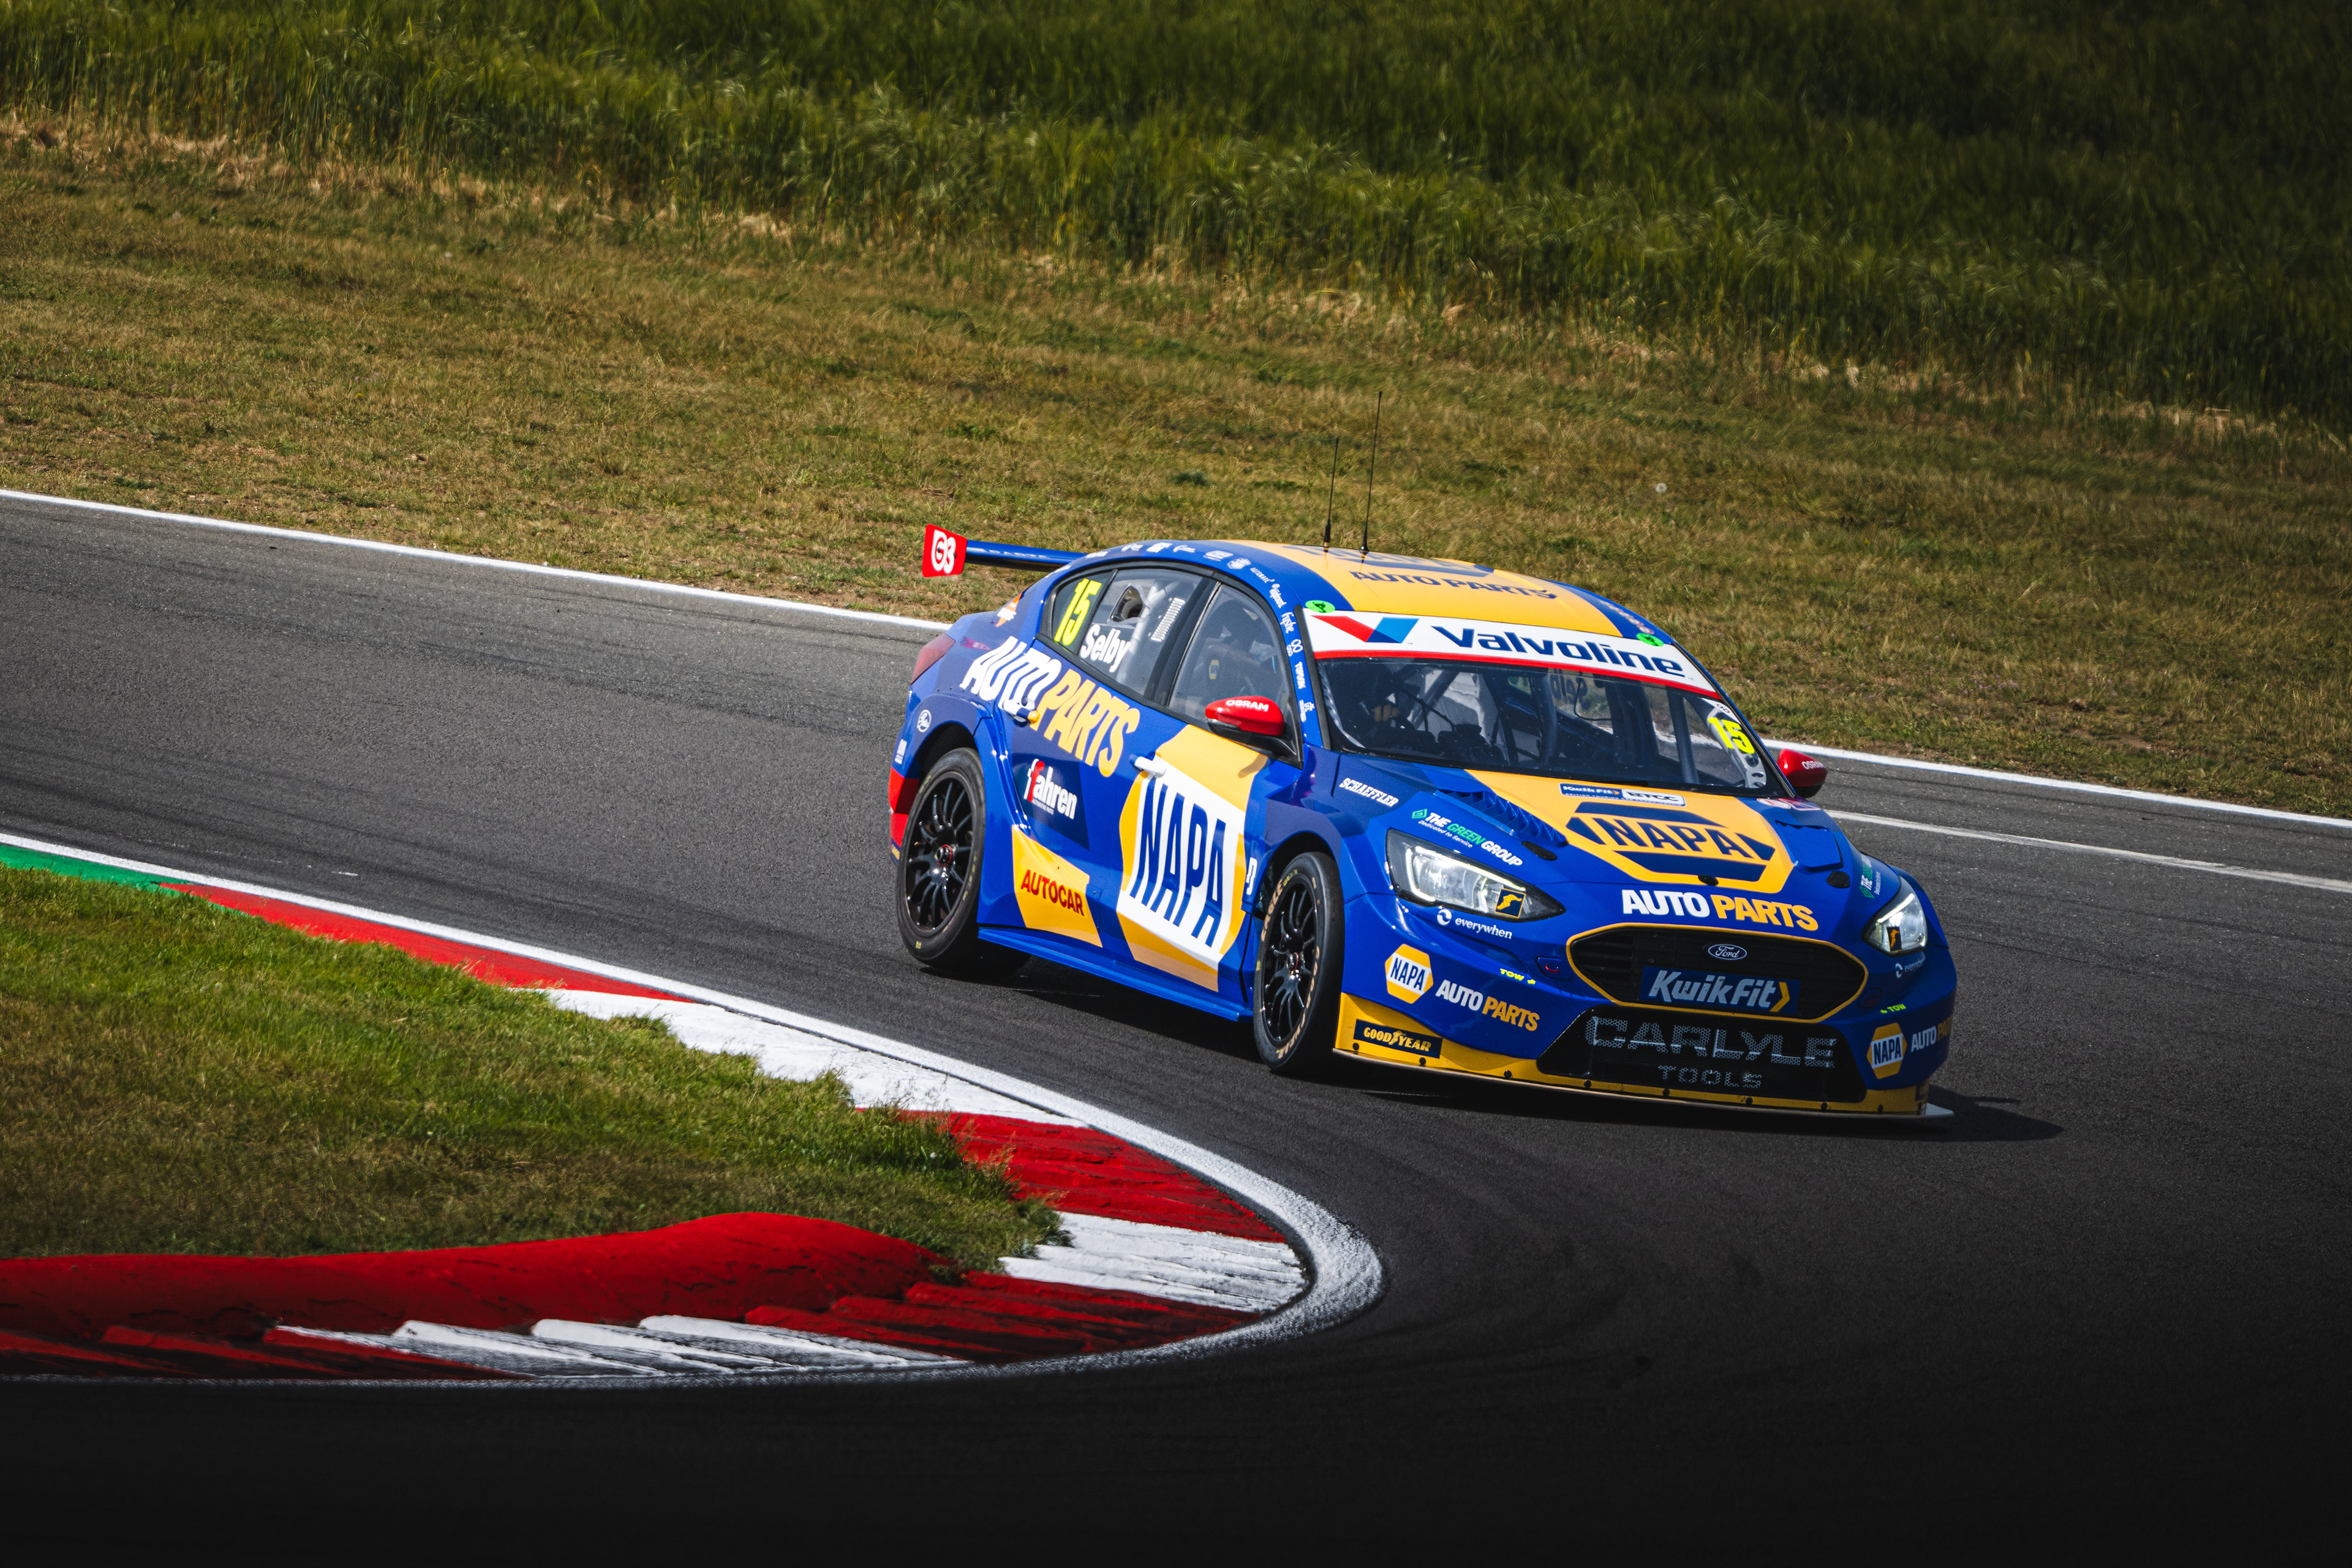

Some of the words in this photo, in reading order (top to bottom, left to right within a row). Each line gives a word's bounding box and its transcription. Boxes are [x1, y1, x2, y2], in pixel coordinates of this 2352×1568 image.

[1348, 570, 1442, 586] AUTO
[1439, 578, 1557, 599] PARTS
[1053, 578, 1102, 647] 15
[1079, 624, 1133, 673] Selby
[1431, 625, 1686, 678] Valvoline
[959, 635, 1062, 710] AUTO
[1030, 668, 1140, 777] PARTS
[1226, 699, 1270, 713] OSRAM
[1706, 717, 1755, 754] 15
[1339, 777, 1400, 807] SCHAEFFLER
[1418, 820, 1447, 834] Dedicated
[1452, 835, 1473, 848] Service
[1425, 812, 1452, 827] THE
[1447, 823, 1487, 845] GREEN
[1481, 840, 1523, 866] GROUP
[1591, 817, 1755, 859] NAPA
[1129, 780, 1227, 948] NAPA
[1020, 869, 1085, 917] AUTOCAR
[1621, 889, 1711, 918] AUTO
[1710, 894, 1819, 932] PARTS
[1455, 917, 1513, 940] everywhen
[1715, 944, 1741, 959] Ford
[1390, 959, 1427, 992] NAPA
[1499, 968, 1526, 981] TOW
[1434, 979, 1484, 1012] AUTO
[1481, 996, 1540, 1032] PARTS
[1887, 1003, 1907, 1012] TOW
[1363, 1027, 1432, 1052] GOODYEAR
[1585, 1015, 1837, 1069] CARLYLE
[1873, 1036, 1903, 1065] NAPA
[1910, 1025, 1937, 1053] AUTO
[1657, 1065, 1763, 1090] TOOLS
